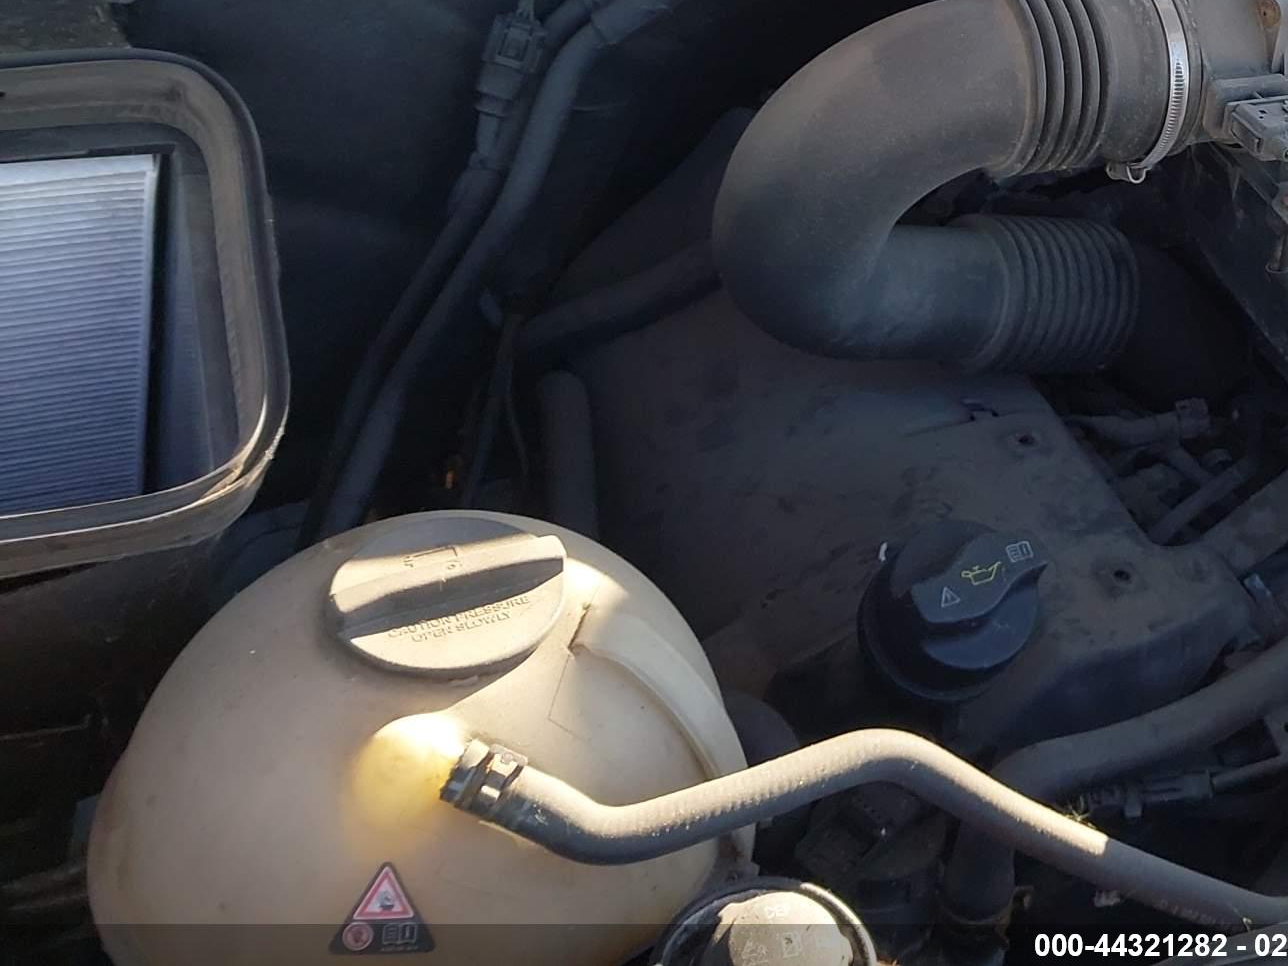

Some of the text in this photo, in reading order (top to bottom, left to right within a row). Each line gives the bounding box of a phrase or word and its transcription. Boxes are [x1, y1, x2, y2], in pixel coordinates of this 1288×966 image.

[387, 595, 531, 638] CAUTION PRESSURE
[455, 611, 512, 633] SLOWLY
